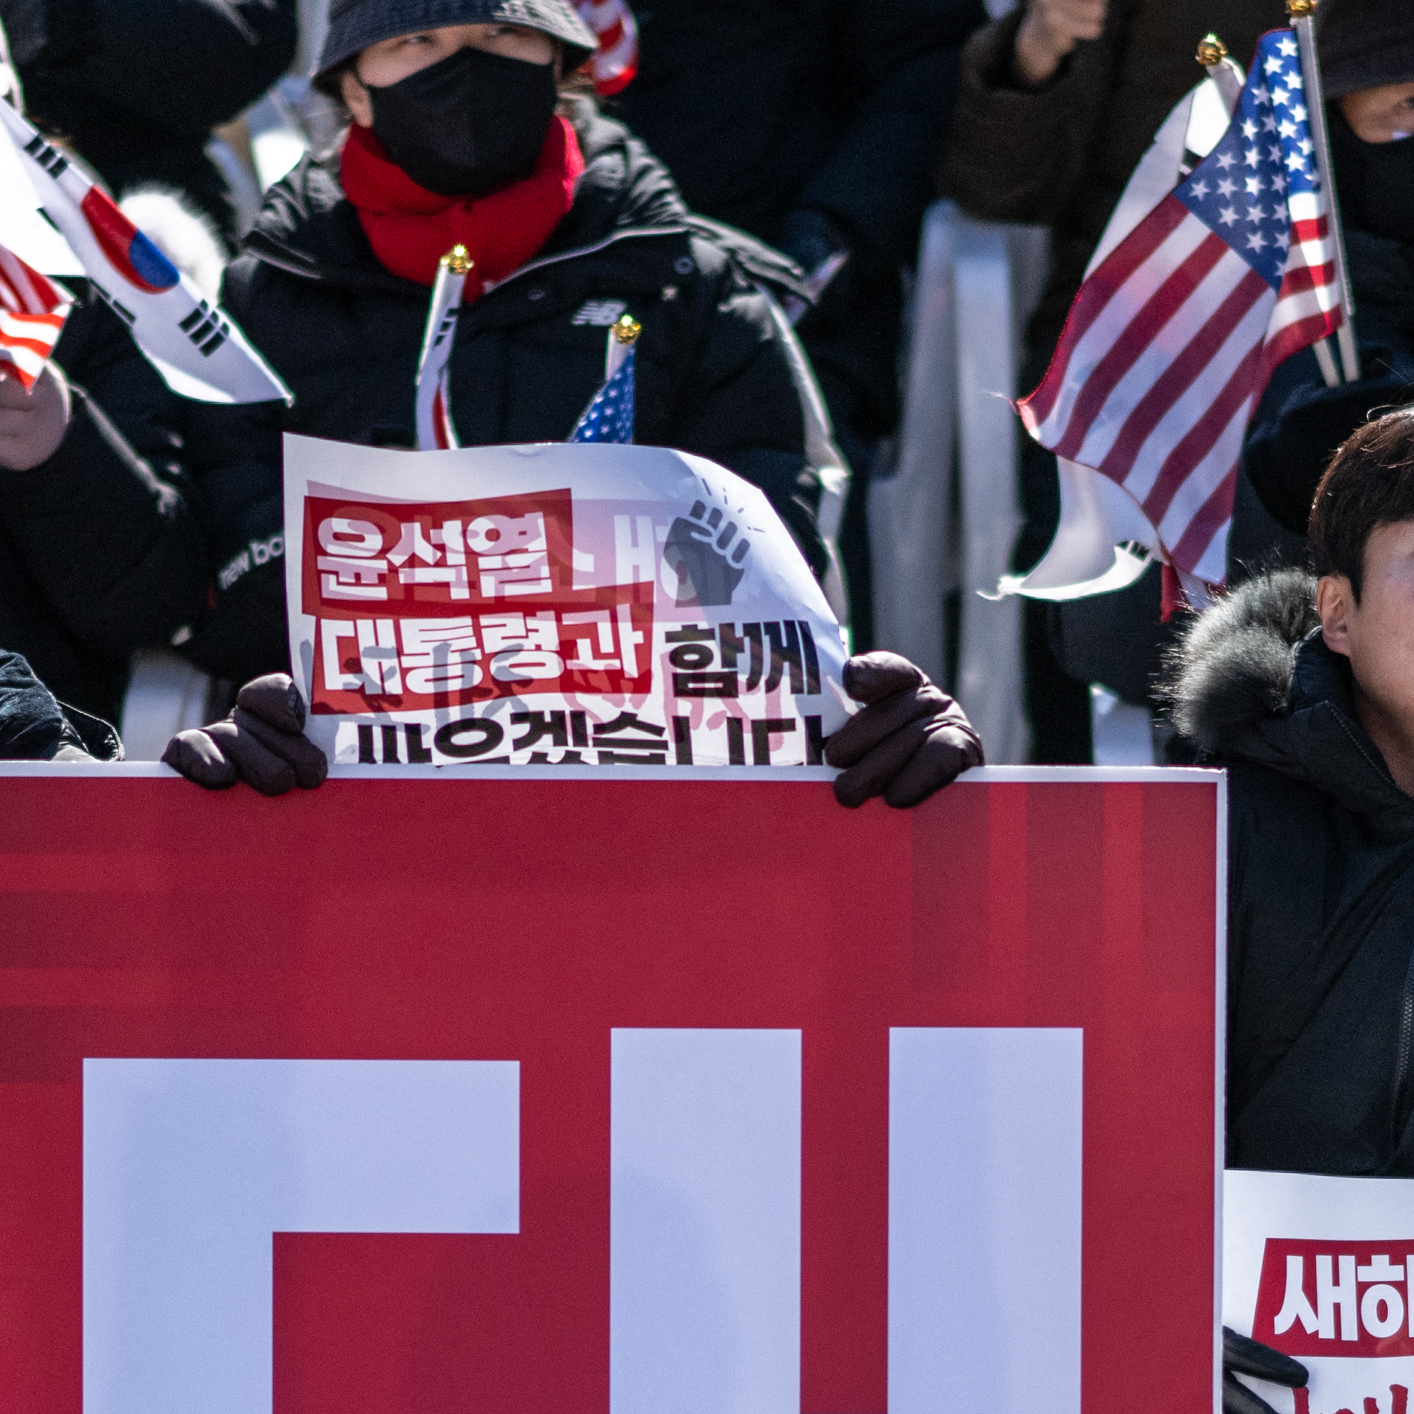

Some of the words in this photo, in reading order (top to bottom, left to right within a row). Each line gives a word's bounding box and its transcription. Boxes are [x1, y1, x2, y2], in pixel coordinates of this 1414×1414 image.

[317, 512, 552, 598] 윤석열
[322, 604, 644, 695] 대통령과
[665, 620, 821, 698] 함께
